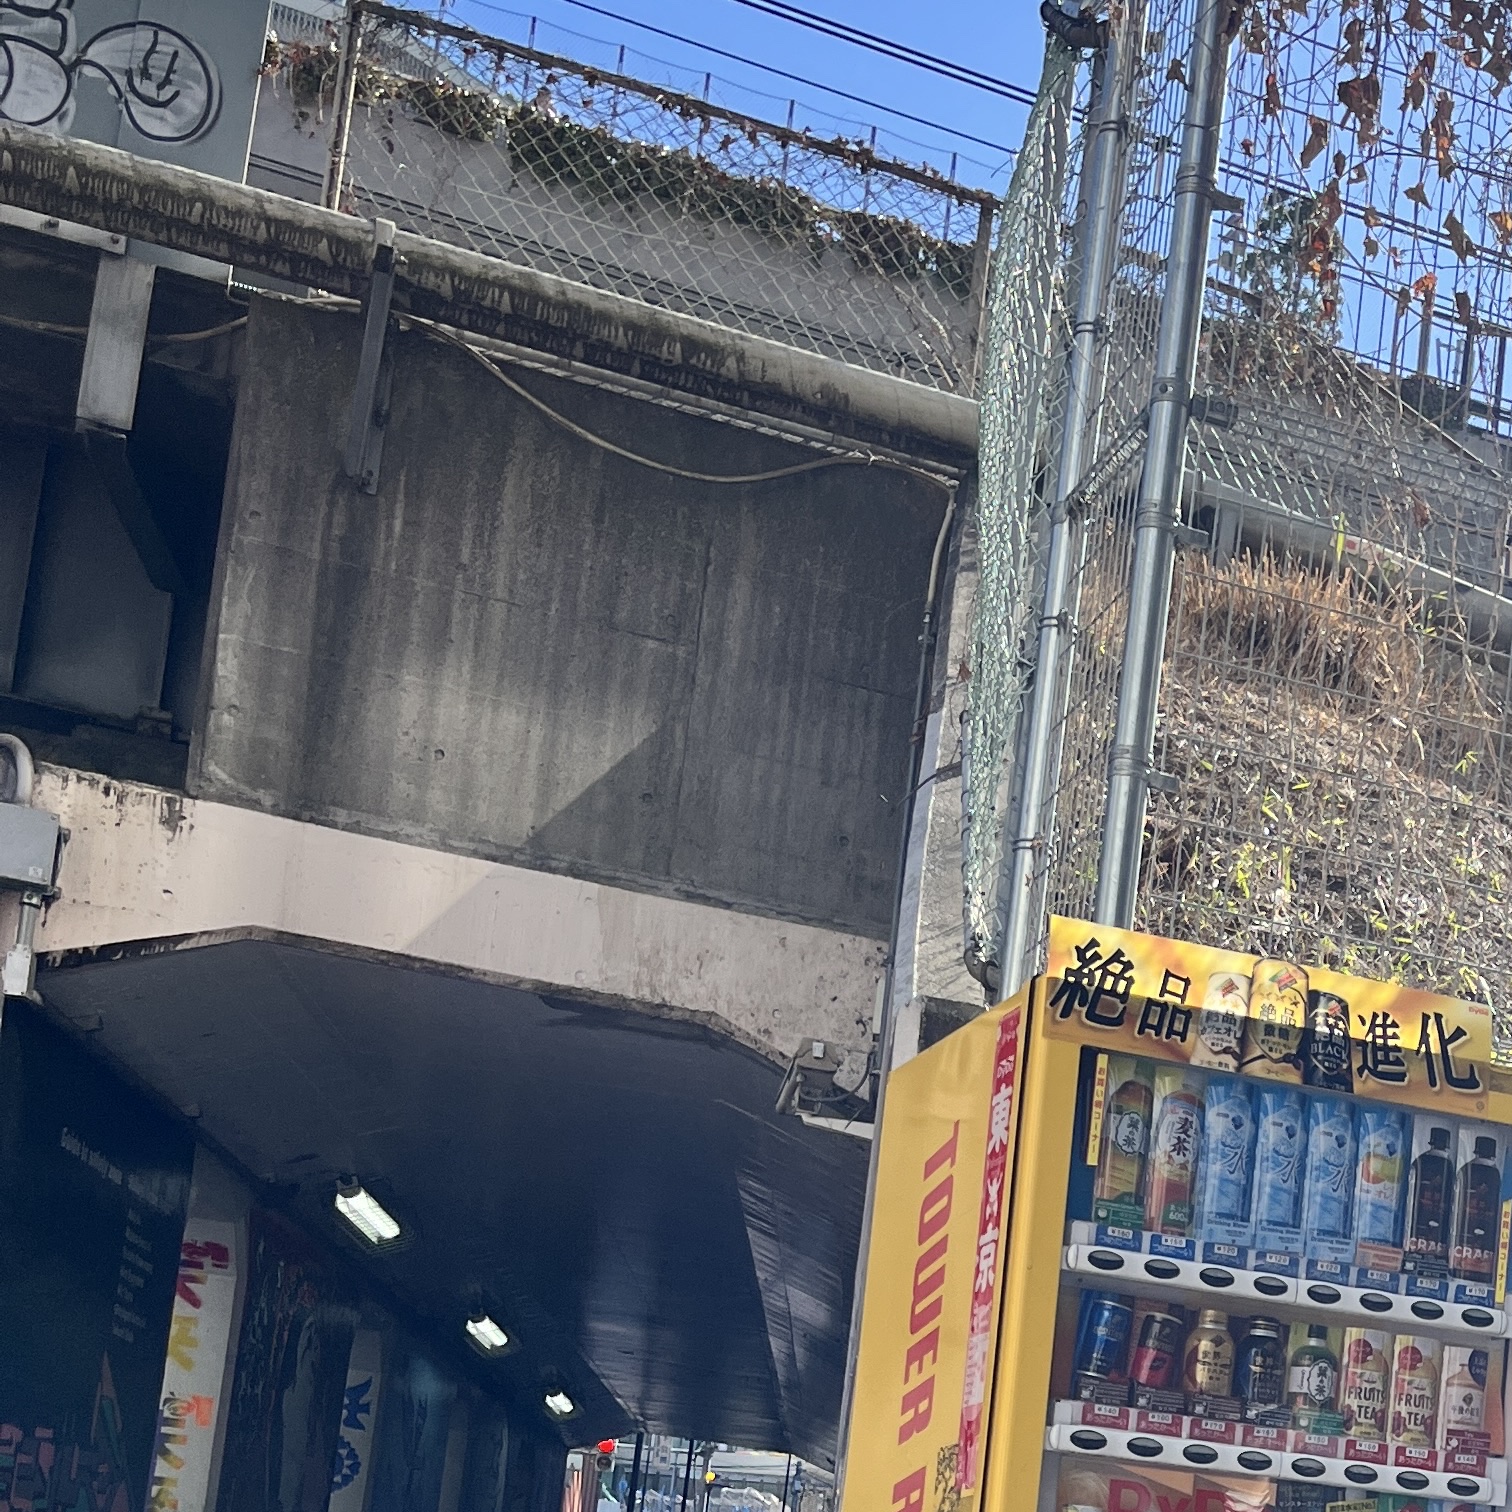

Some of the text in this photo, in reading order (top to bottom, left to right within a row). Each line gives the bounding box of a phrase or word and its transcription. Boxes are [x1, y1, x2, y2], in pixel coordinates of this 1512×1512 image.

[1049, 936, 1482, 1089] 絶品 進化
[898, 1120, 960, 1446] TOWER
[1347, 1385, 1386, 1404] FRUITS
[1356, 1404, 1377, 1420] TEA
[1407, 1411, 1425, 1427] TEA
